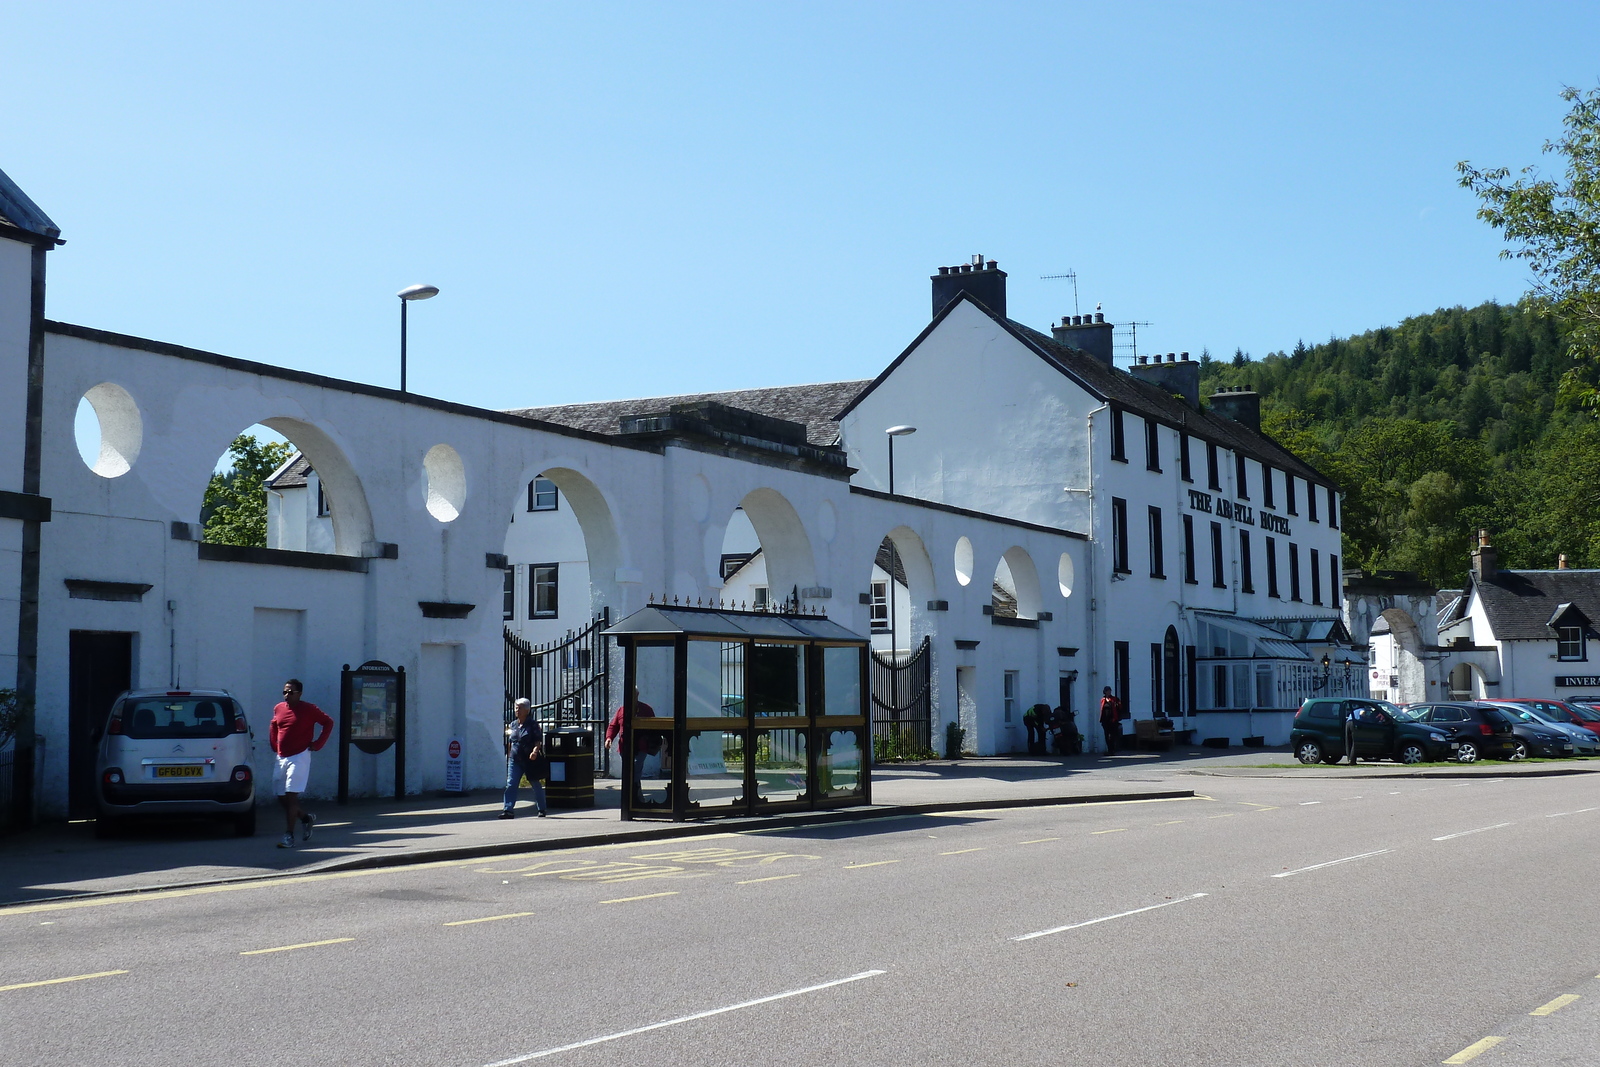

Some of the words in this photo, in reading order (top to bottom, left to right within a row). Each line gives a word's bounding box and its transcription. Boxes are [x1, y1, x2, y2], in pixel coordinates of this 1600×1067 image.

[1188, 489, 1212, 514] THE
[1260, 510, 1292, 536] HOTEL
[158, 767, 183, 776] GF60
[184, 767, 202, 776] GVX
[630, 847, 823, 868] BUS
